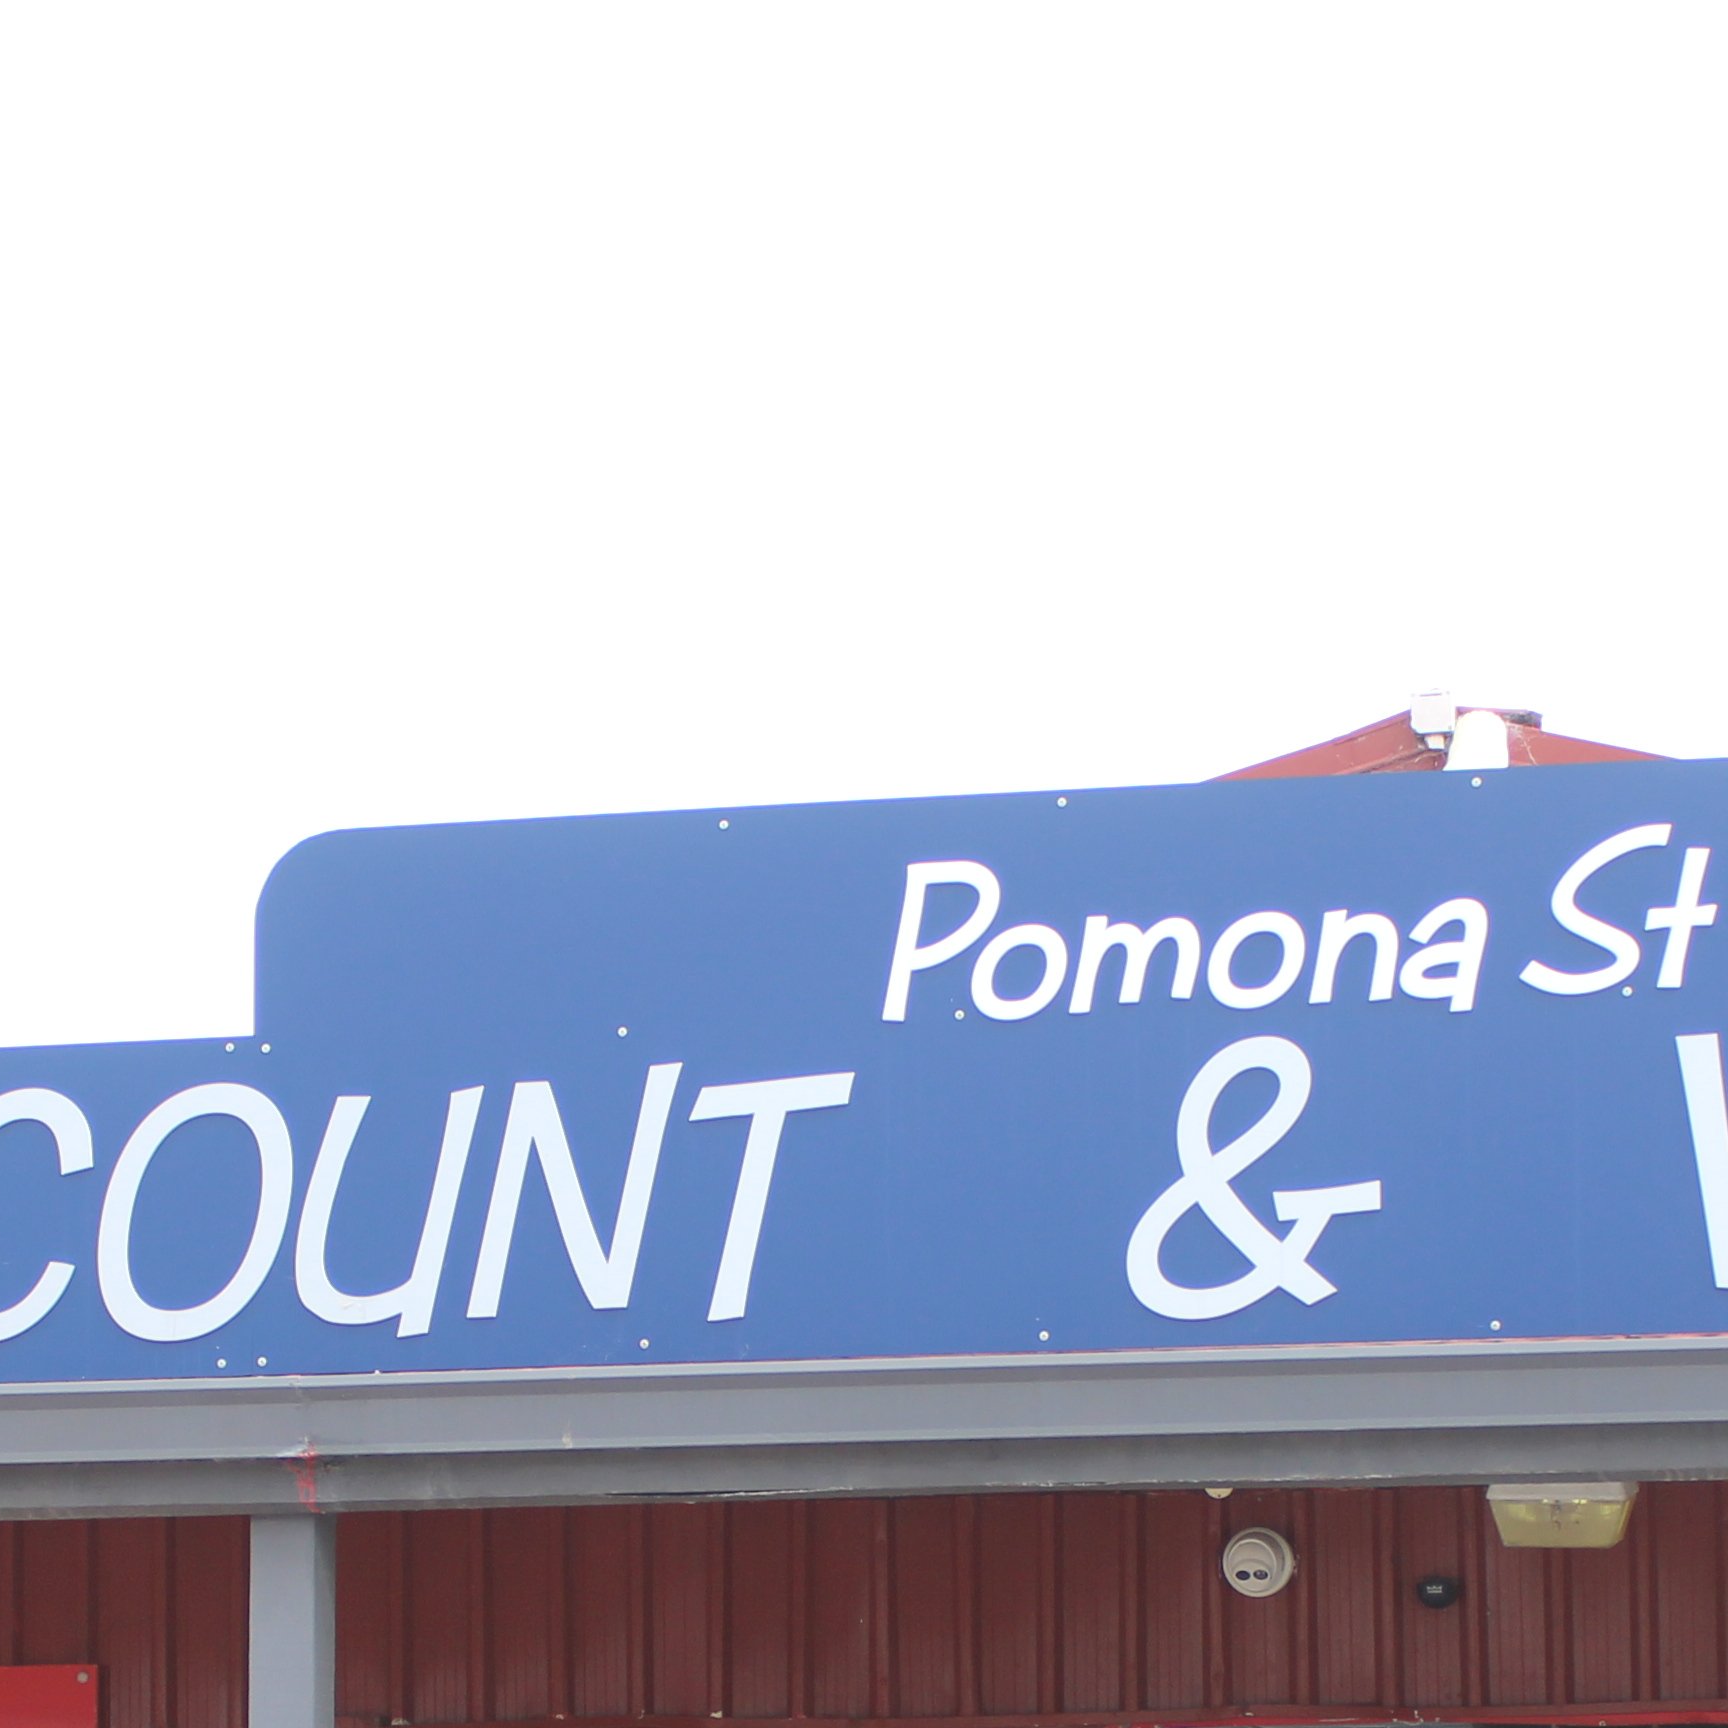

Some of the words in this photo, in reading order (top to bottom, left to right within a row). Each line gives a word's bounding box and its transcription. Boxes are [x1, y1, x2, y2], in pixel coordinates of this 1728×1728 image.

[882, 858, 1489, 1022] Pomona
[1518, 822, 1719, 996] St
[1125, 1034, 1383, 1321] &
